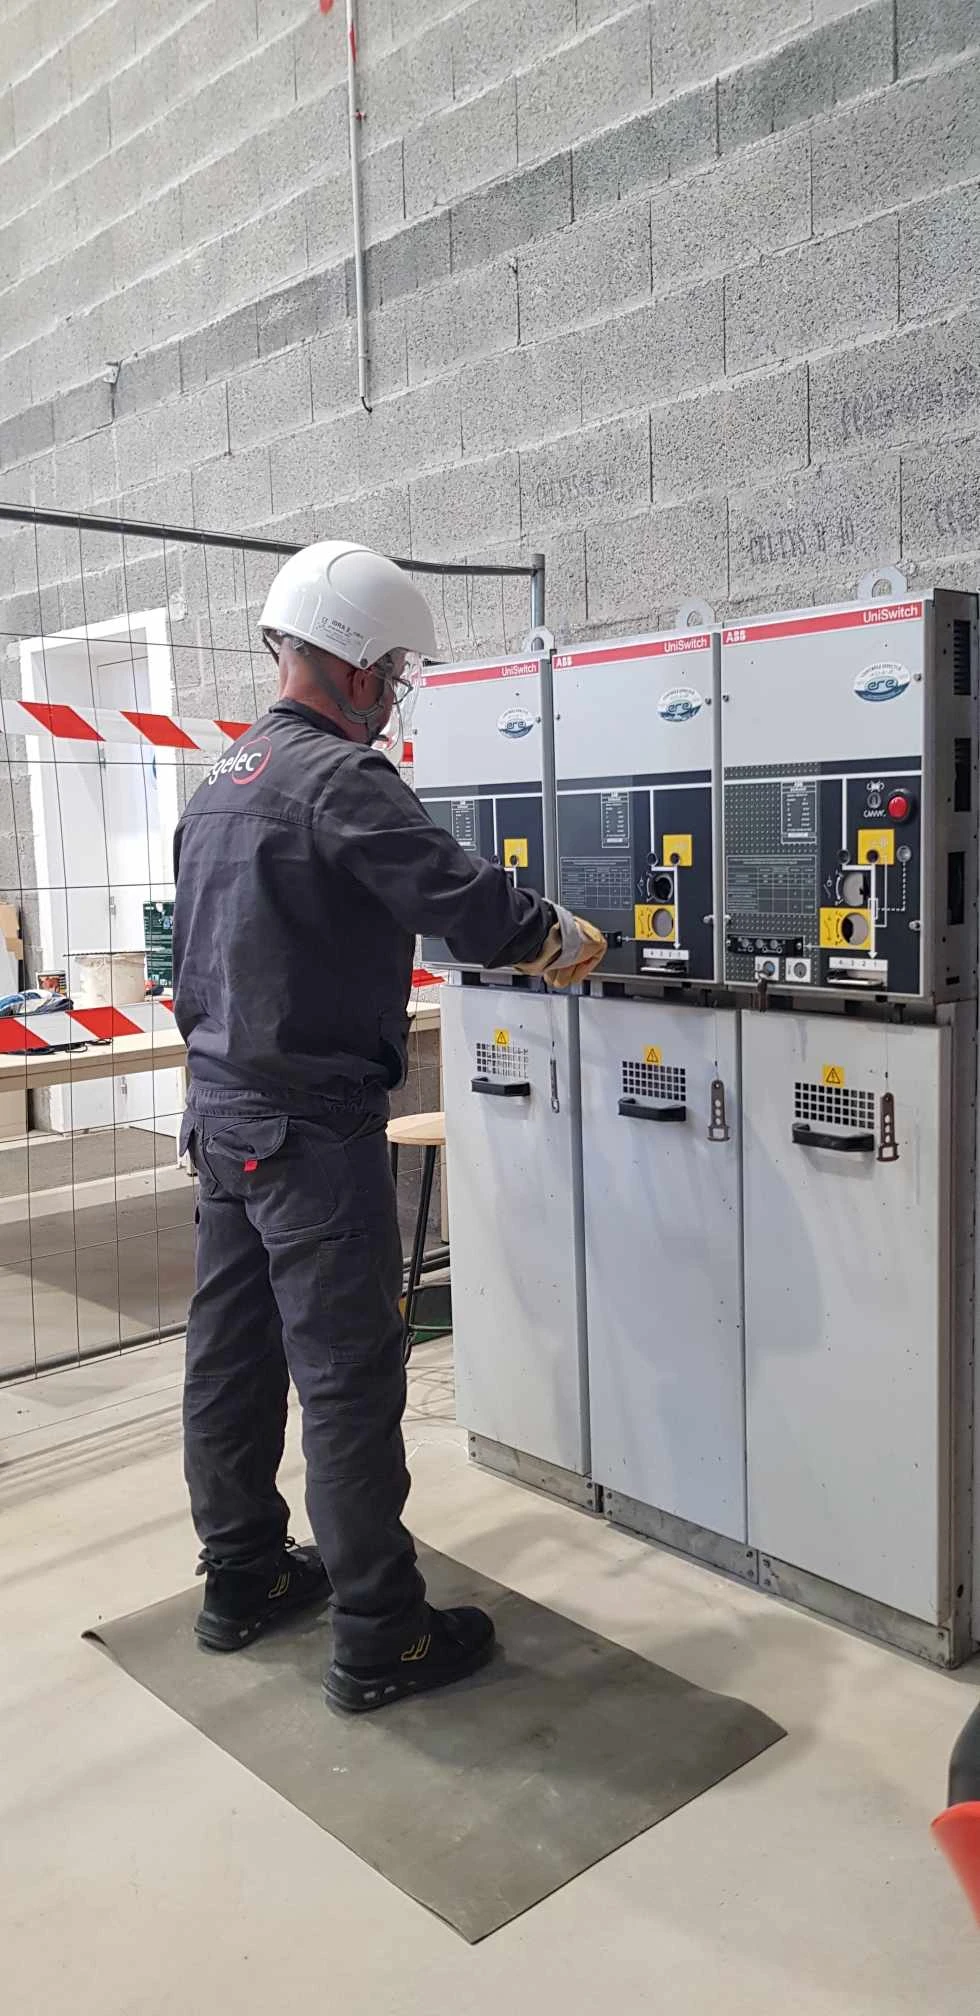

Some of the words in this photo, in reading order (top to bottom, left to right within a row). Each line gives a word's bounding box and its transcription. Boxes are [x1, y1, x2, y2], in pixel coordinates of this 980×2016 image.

[863, 604, 918, 623] UniSwitch
[725, 630, 746, 643] ABB
[664, 637, 708, 653] UniSwitch
[556, 656, 572, 667] ABB
[501, 663, 537, 677] UniSwitch
